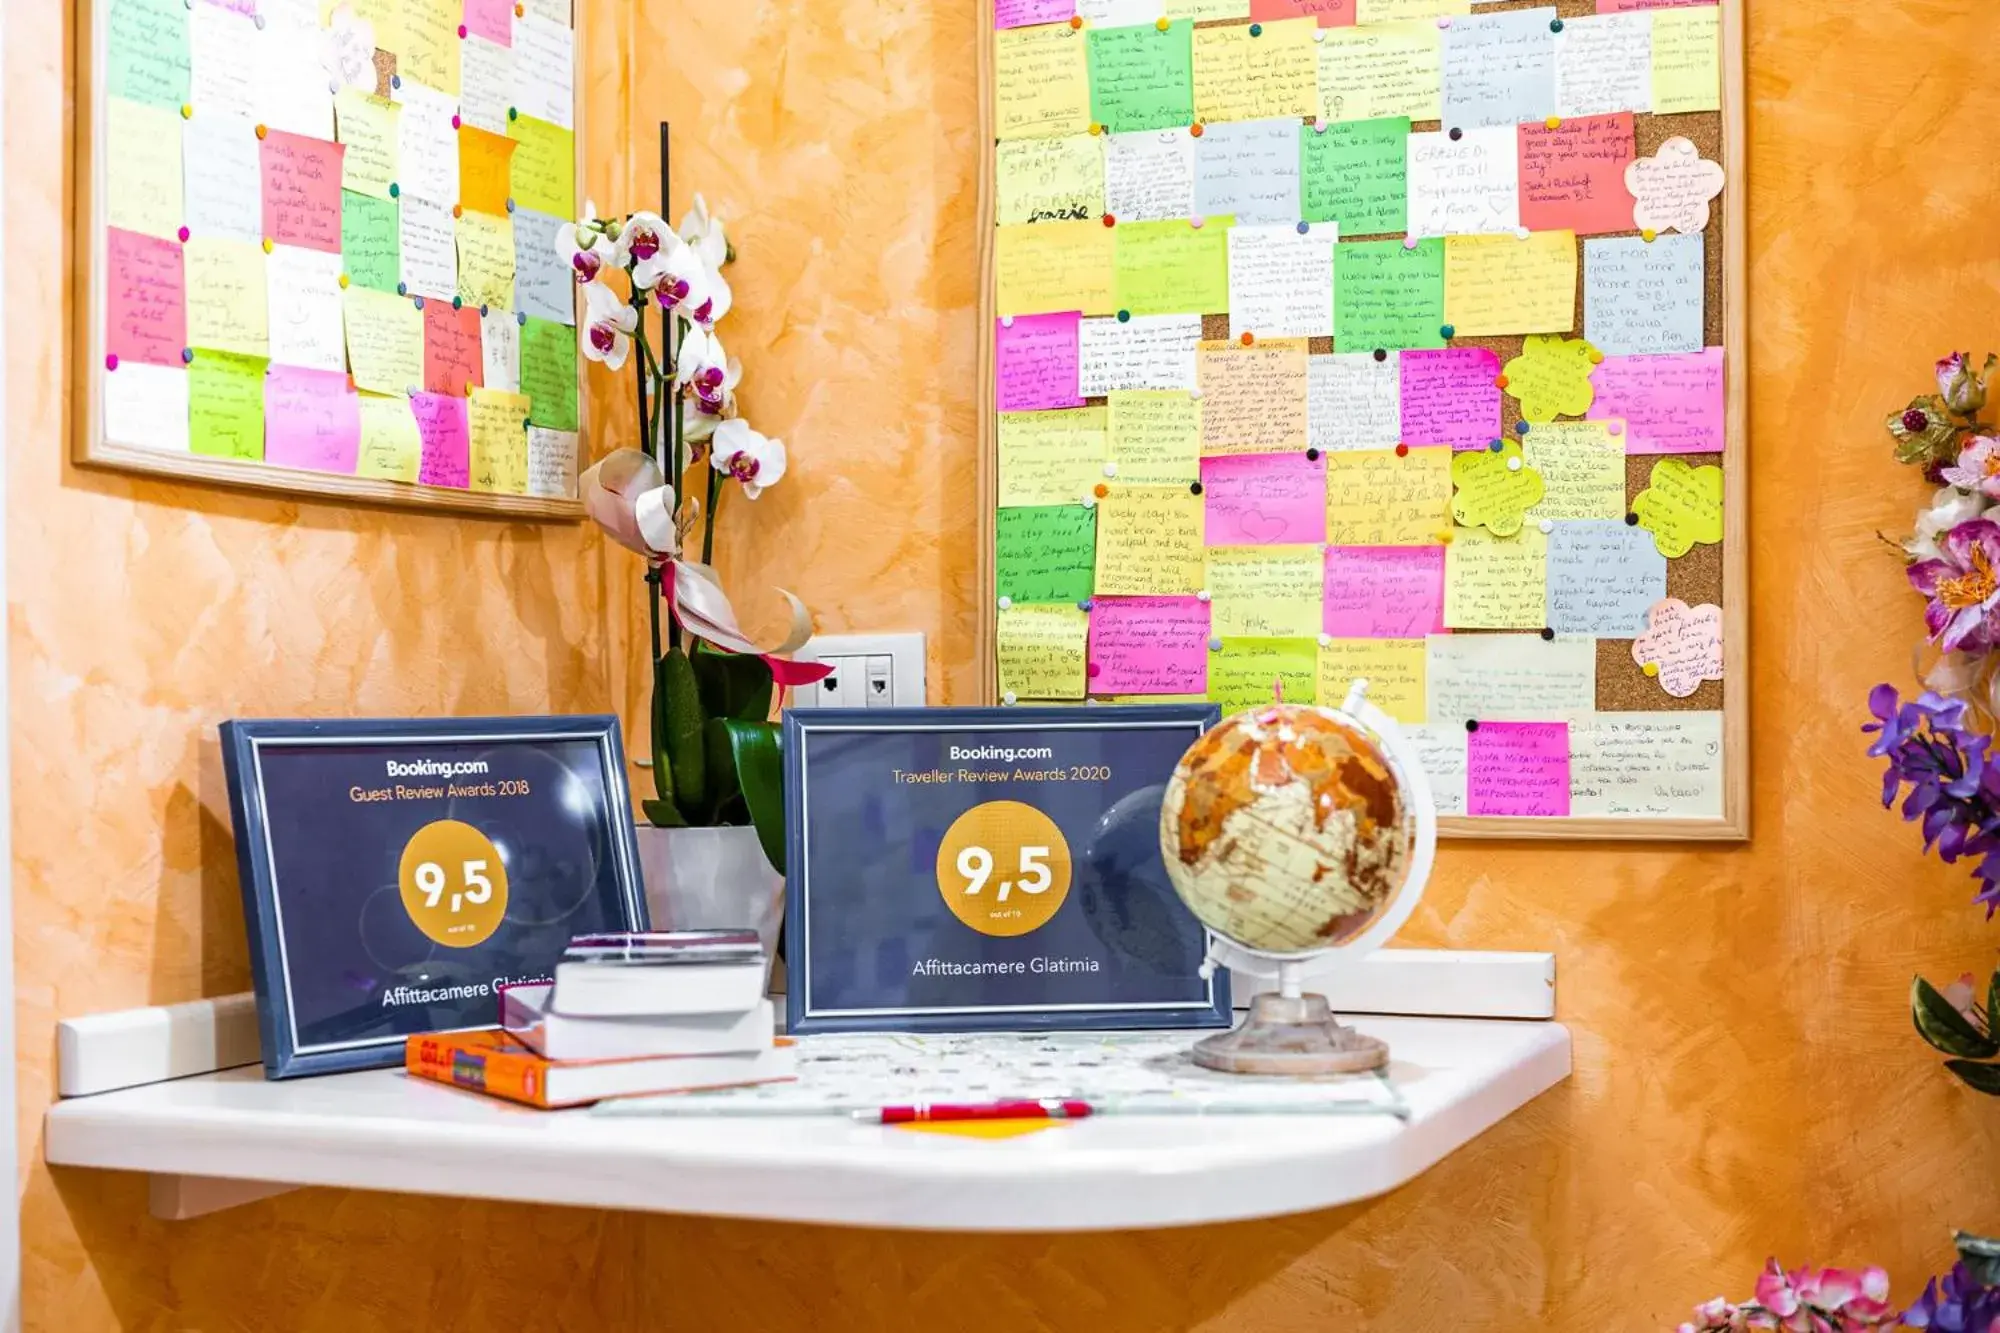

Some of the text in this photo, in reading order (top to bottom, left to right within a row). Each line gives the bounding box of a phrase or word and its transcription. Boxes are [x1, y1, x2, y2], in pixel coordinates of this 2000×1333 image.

[950, 745, 1051, 762] Booking.com
[386, 759, 489, 778] Booking.com
[893, 765, 1111, 784] Traveller Review Awards 2020
[349, 779, 531, 803] Guest Review Awards 2018
[956, 845, 1052, 902] 9,5
[414, 860, 494, 913] 9,5
[913, 957, 1099, 976] Affittacamere Glatimia
[382, 984, 488, 1008] Affittacamere
